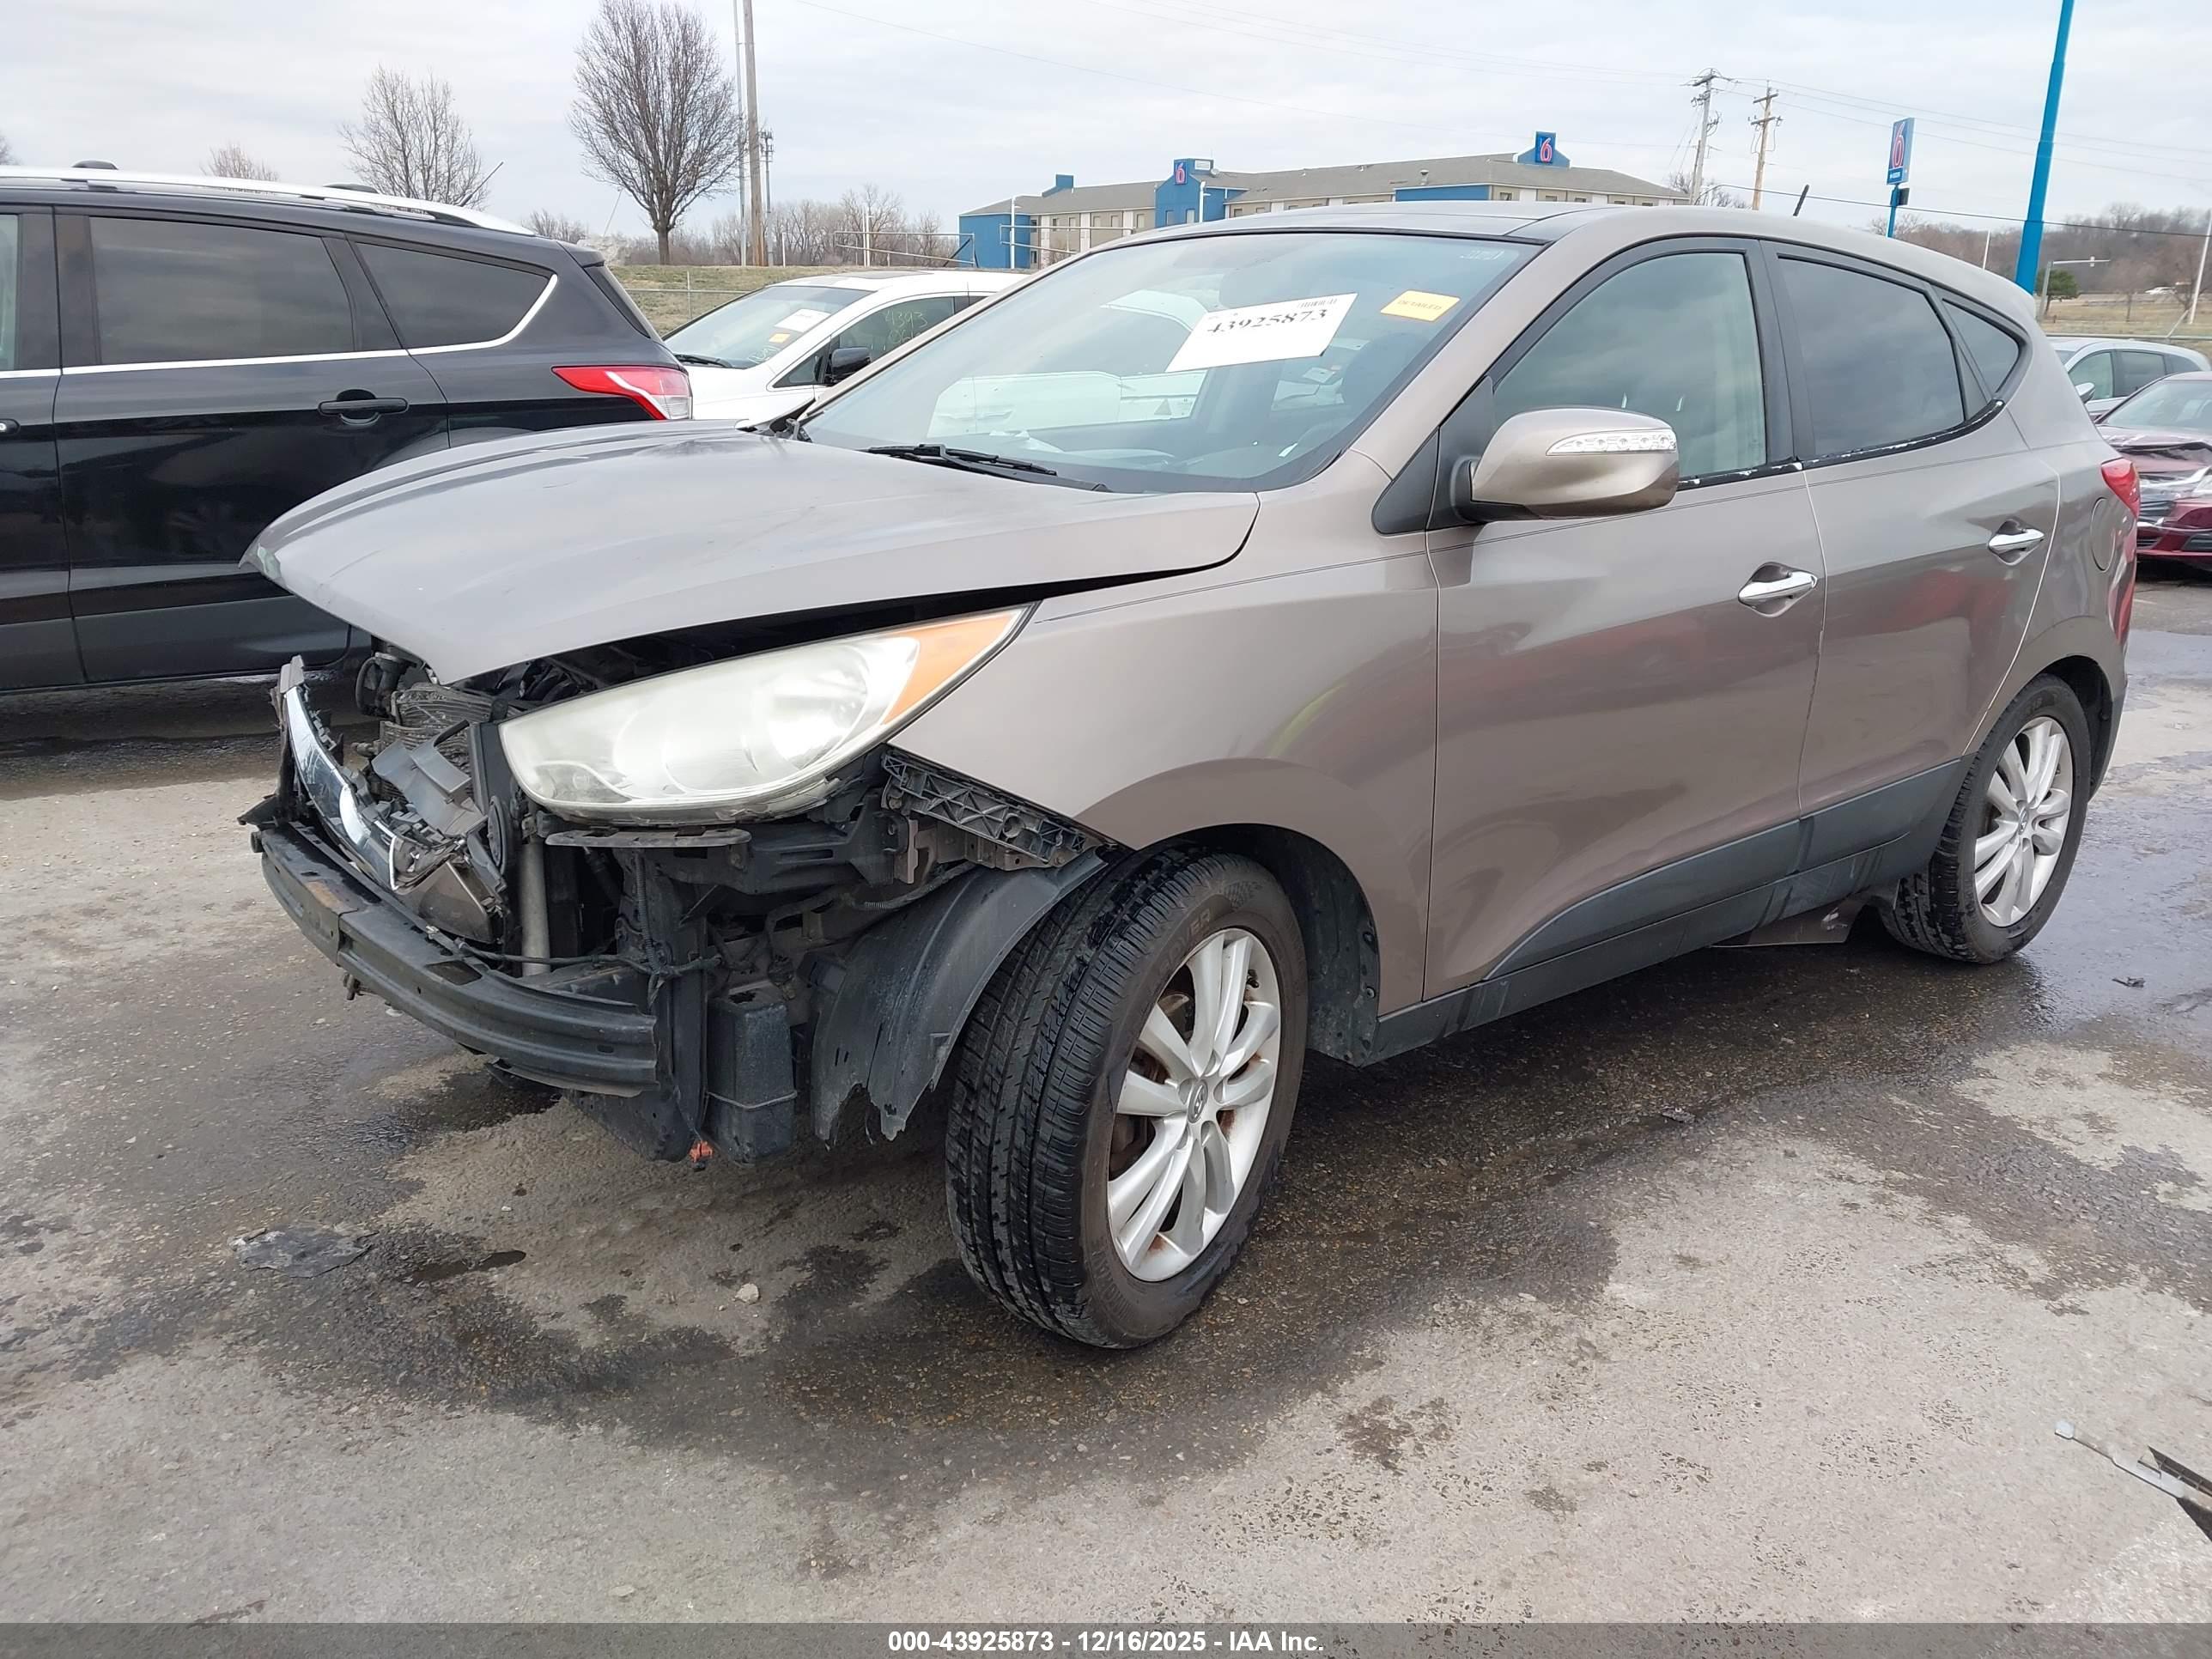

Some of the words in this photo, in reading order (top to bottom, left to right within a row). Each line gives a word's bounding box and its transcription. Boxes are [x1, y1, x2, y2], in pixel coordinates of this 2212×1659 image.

[1540, 137, 1553, 162] 6
[1892, 121, 1905, 169] 6
[1176, 162, 1185, 184] 6
[1206, 308, 1328, 336] 43925873
